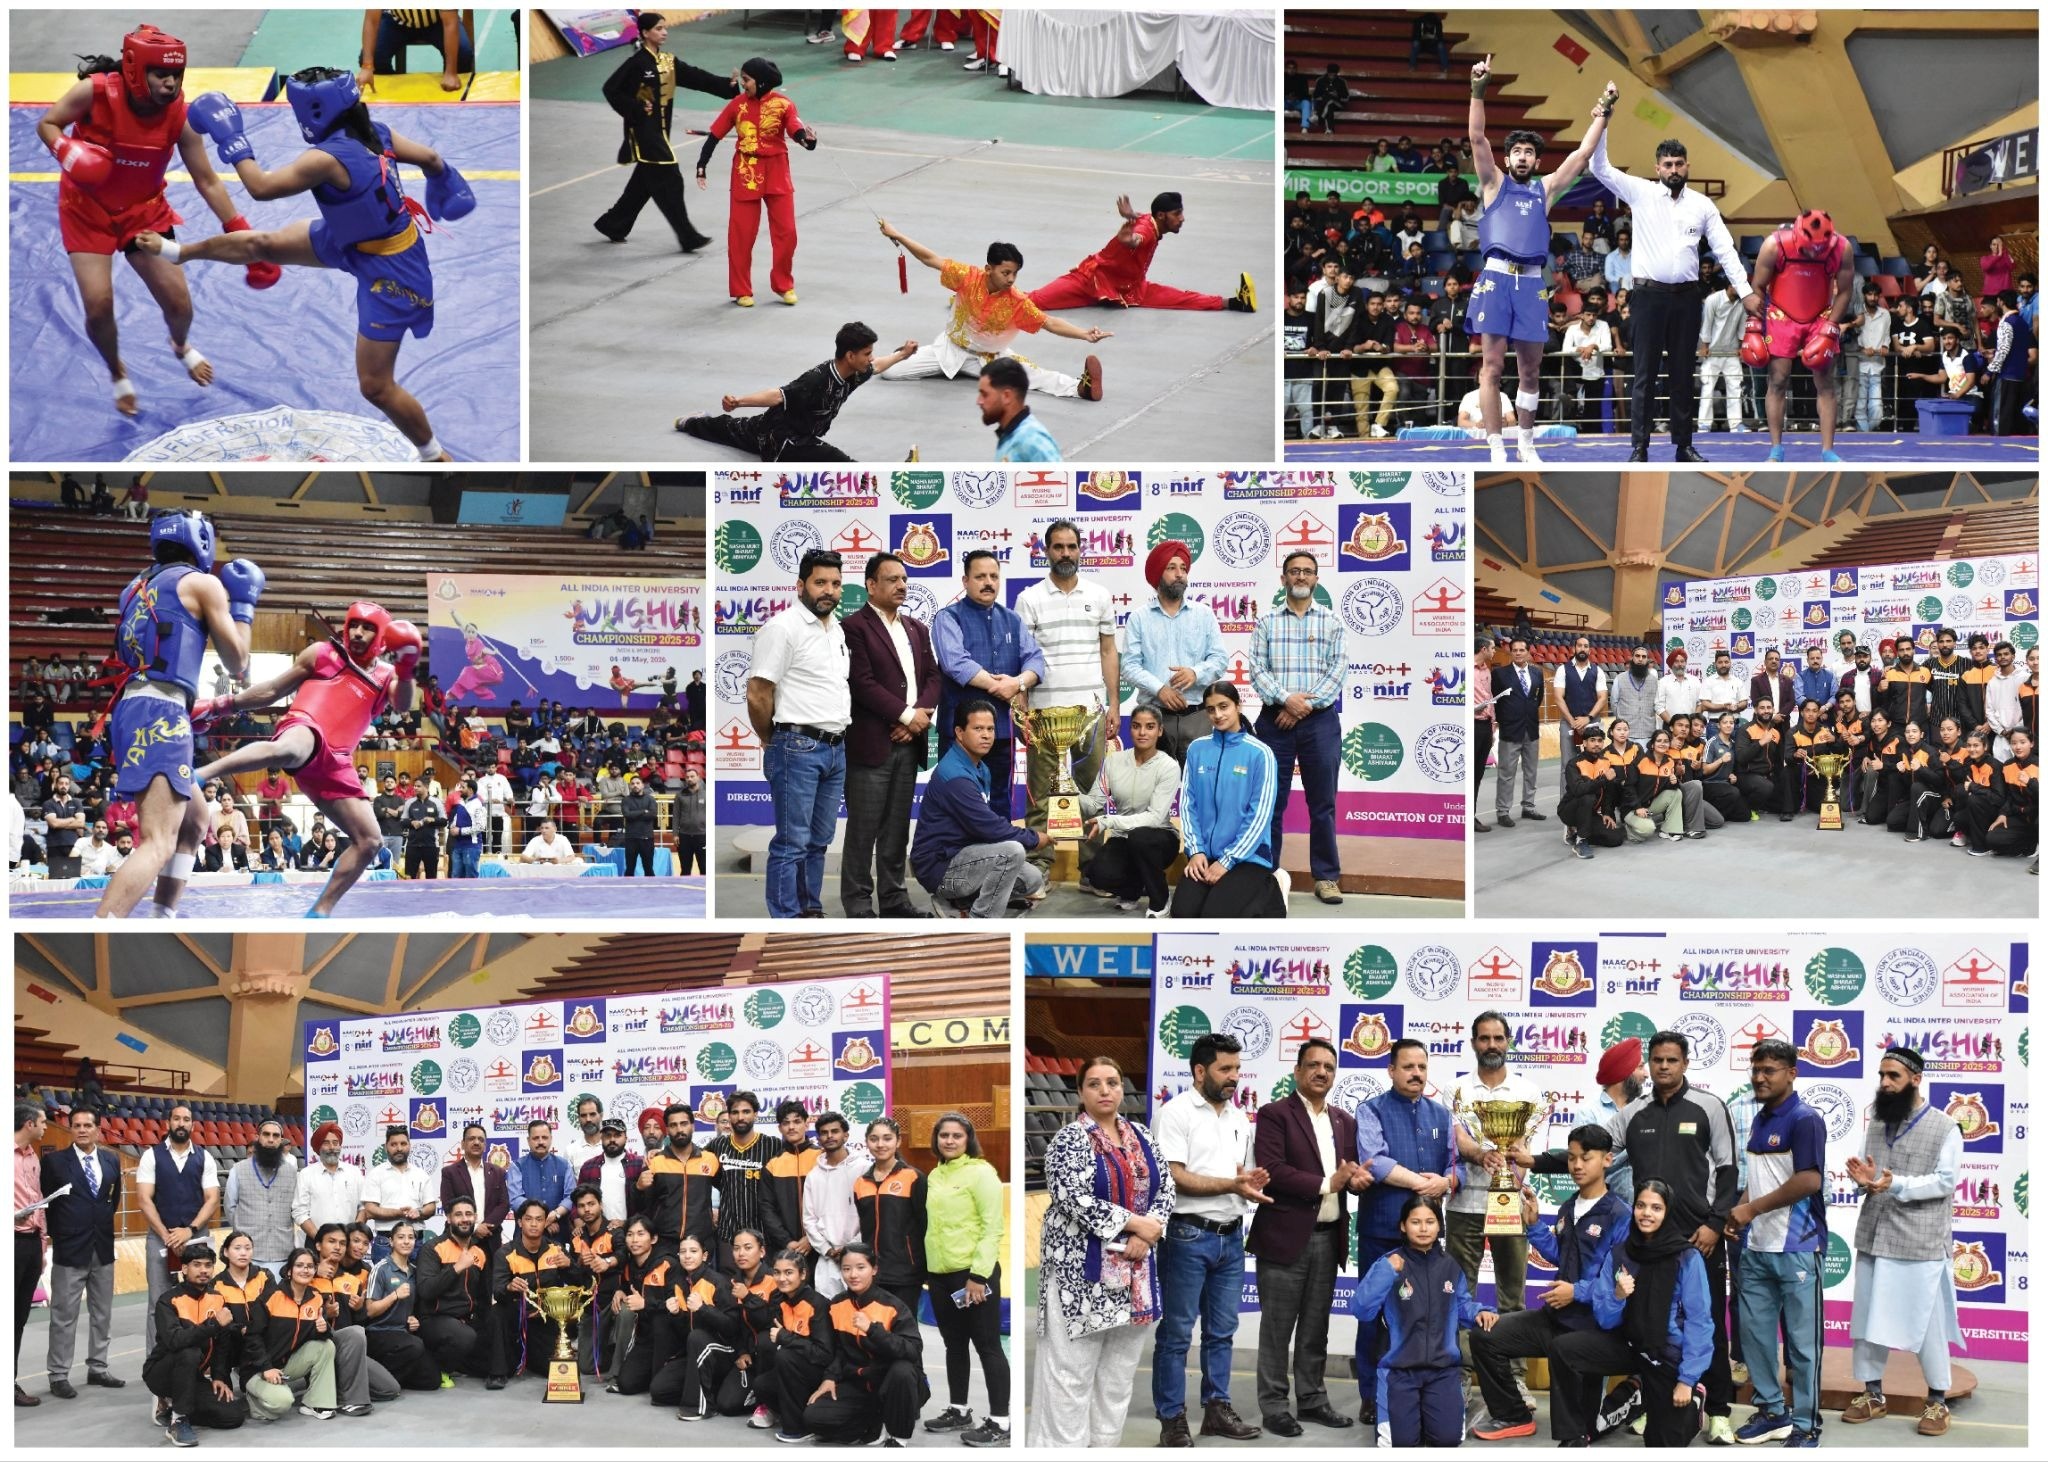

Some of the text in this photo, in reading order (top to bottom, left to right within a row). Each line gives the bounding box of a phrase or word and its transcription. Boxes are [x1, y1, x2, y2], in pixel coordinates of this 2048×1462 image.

[116, 158, 150, 167] RXN
[1984, 133, 2039, 178] WE
[1318, 178, 1390, 195] INDOOR
[730, 485, 763, 501] nirf
[1152, 477, 1206, 496] 8 nirf
[1227, 487, 1331, 499] CHAMPIONSHIP 2025-26
[782, 498, 875, 507] CHAMPIONSHIP 2025-26
[1225, 512, 1260, 526] OF INDIAN
[560, 584, 701, 595] ALL INDIA INTER UNIVERSITY
[1353, 579, 1391, 591] OF INDIAN
[1222, 624, 1254, 632] 2025-26
[576, 632, 697, 646] CHAMPIONSHIP 2025-26
[1353, 680, 1412, 699] 8 nirf
[1427, 726, 1436, 737] OF
[1345, 811, 1444, 823] ASSOCIATION OF
[1053, 946, 1152, 975] WEL
[1888, 950, 1926, 961] OF INDIAN
[1233, 957, 1323, 985] WUSHU
[1684, 961, 1782, 988] WUSHU
[1165, 971, 1215, 989] 8 nirf
[1607, 975, 1662, 994] 8 nirf
[1879, 960, 1936, 1003] ASSOCIATION UNIVERSITIES
[1233, 986, 1327, 995] CHAMPIONSHIP 2025-26
[1682, 991, 1786, 1000] CHAMPIONSHIP 2025-26
[663, 1003, 728, 1023] WUSHU
[1231, 1009, 1240, 1017] OF
[1240, 1007, 1263, 1019] INDIAN
[612, 1018, 649, 1033] 8 nirf
[890, 1018, 1011, 1046] COM
[1429, 1038, 1465, 1053] nirf
[1680, 1015, 1726, 1067] OF INDIAN UNIVERSITIES
[619, 1055, 682, 1074] WUSHU
[1551, 1054, 1583, 1062] 2025-26
[1962, 1062, 1998, 1071] 2025-26
[569, 1068, 605, 1083] 8 nirf
[1352, 1076, 1376, 1085] INDIAN
[2015, 1126, 2025, 1139] 8
[719, 1153, 763, 1169] Champions
[1960, 1208, 1996, 1217] 2025-26
[2018, 1277, 2028, 1290] 8
